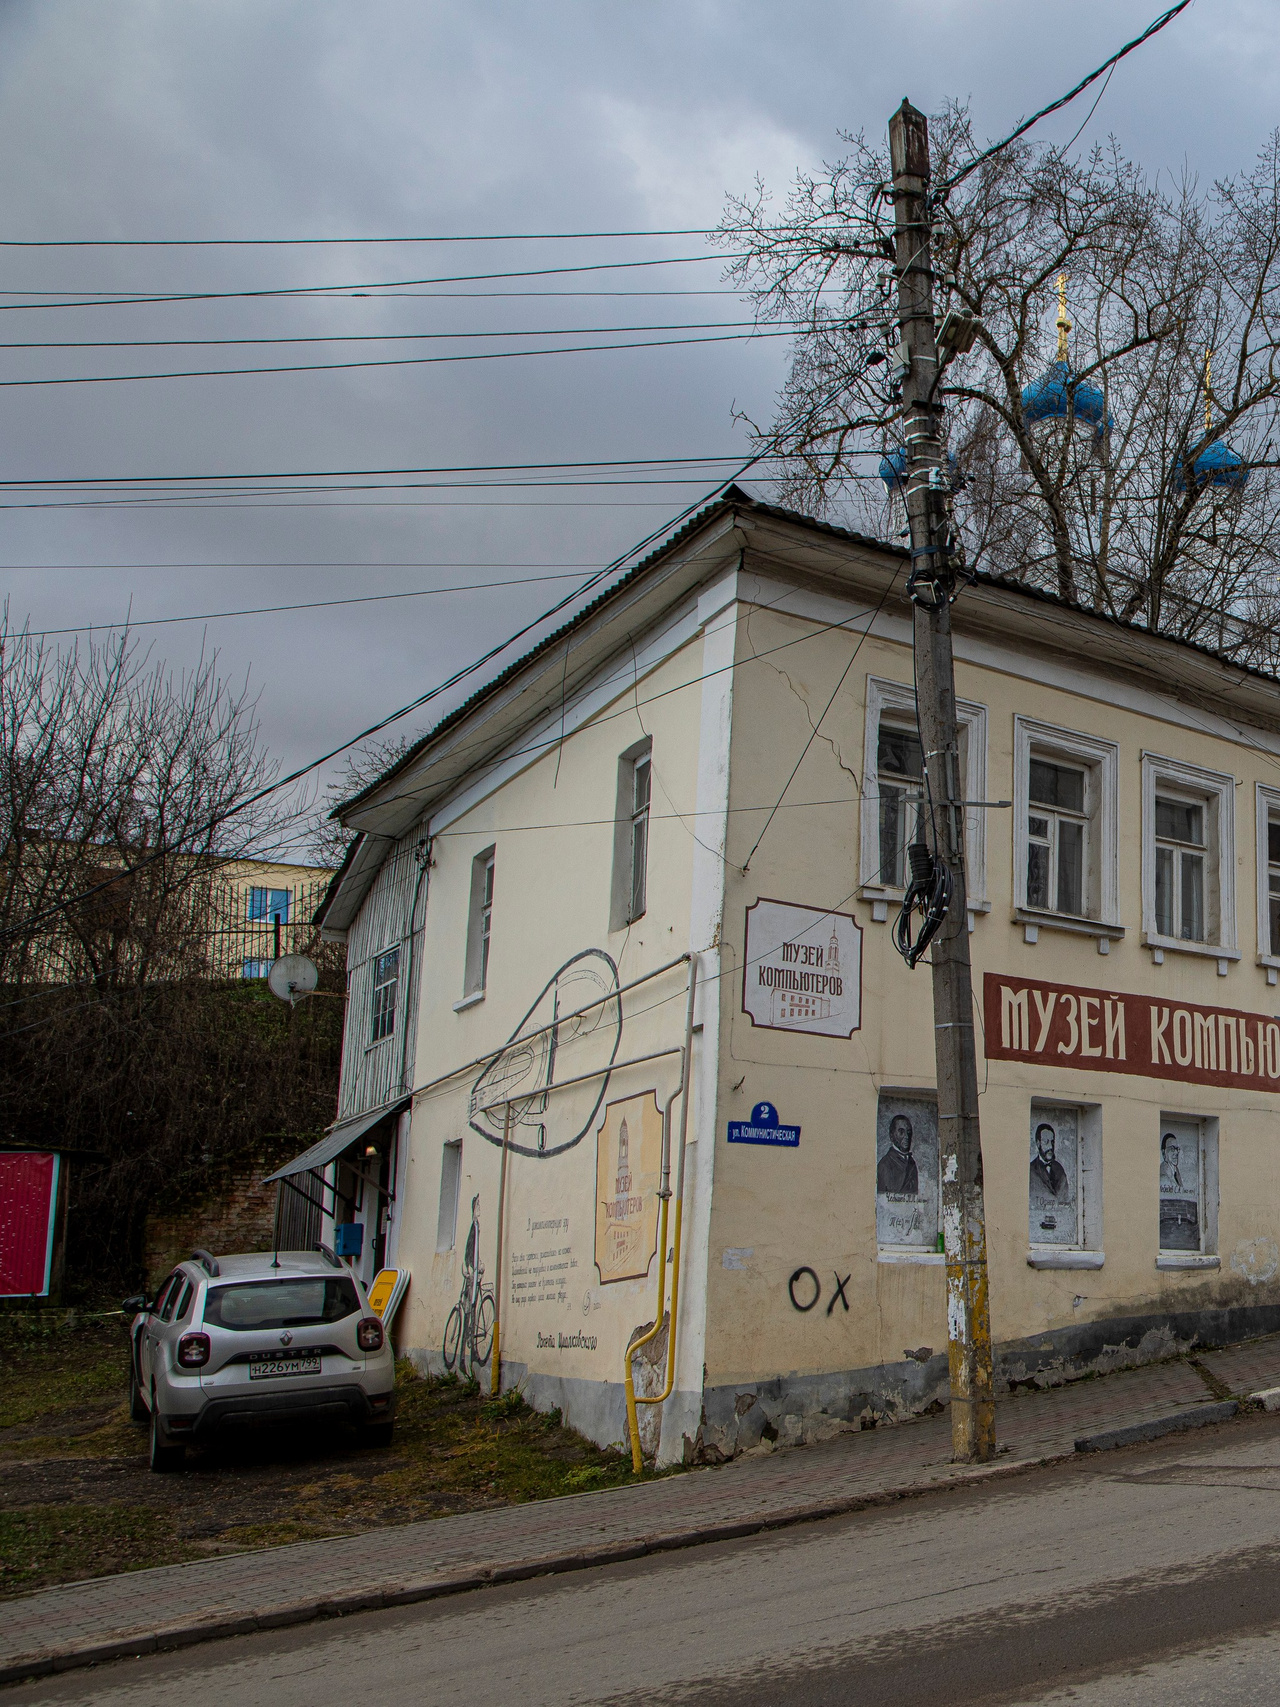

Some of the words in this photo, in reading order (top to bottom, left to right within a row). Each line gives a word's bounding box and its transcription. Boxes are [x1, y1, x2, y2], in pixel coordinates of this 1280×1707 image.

[782, 942, 824, 967] МУЗЕЙ
[758, 965, 843, 996] КОМПЬЮТЕРОВ
[999, 985, 1127, 1060] МУЗЕЙ
[760, 1105, 769, 1118] 2
[732, 1128, 740, 1140] ул.
[615, 1171, 632, 1194] МУЗЕЙ
[605, 1196, 642, 1219] КОМПЬЮТЕРОВ
[249, 1348, 321, 1359] DUSTER
[254, 1361, 299, 1375] Н226УМ
[301, 1358, 317, 1368] 799
